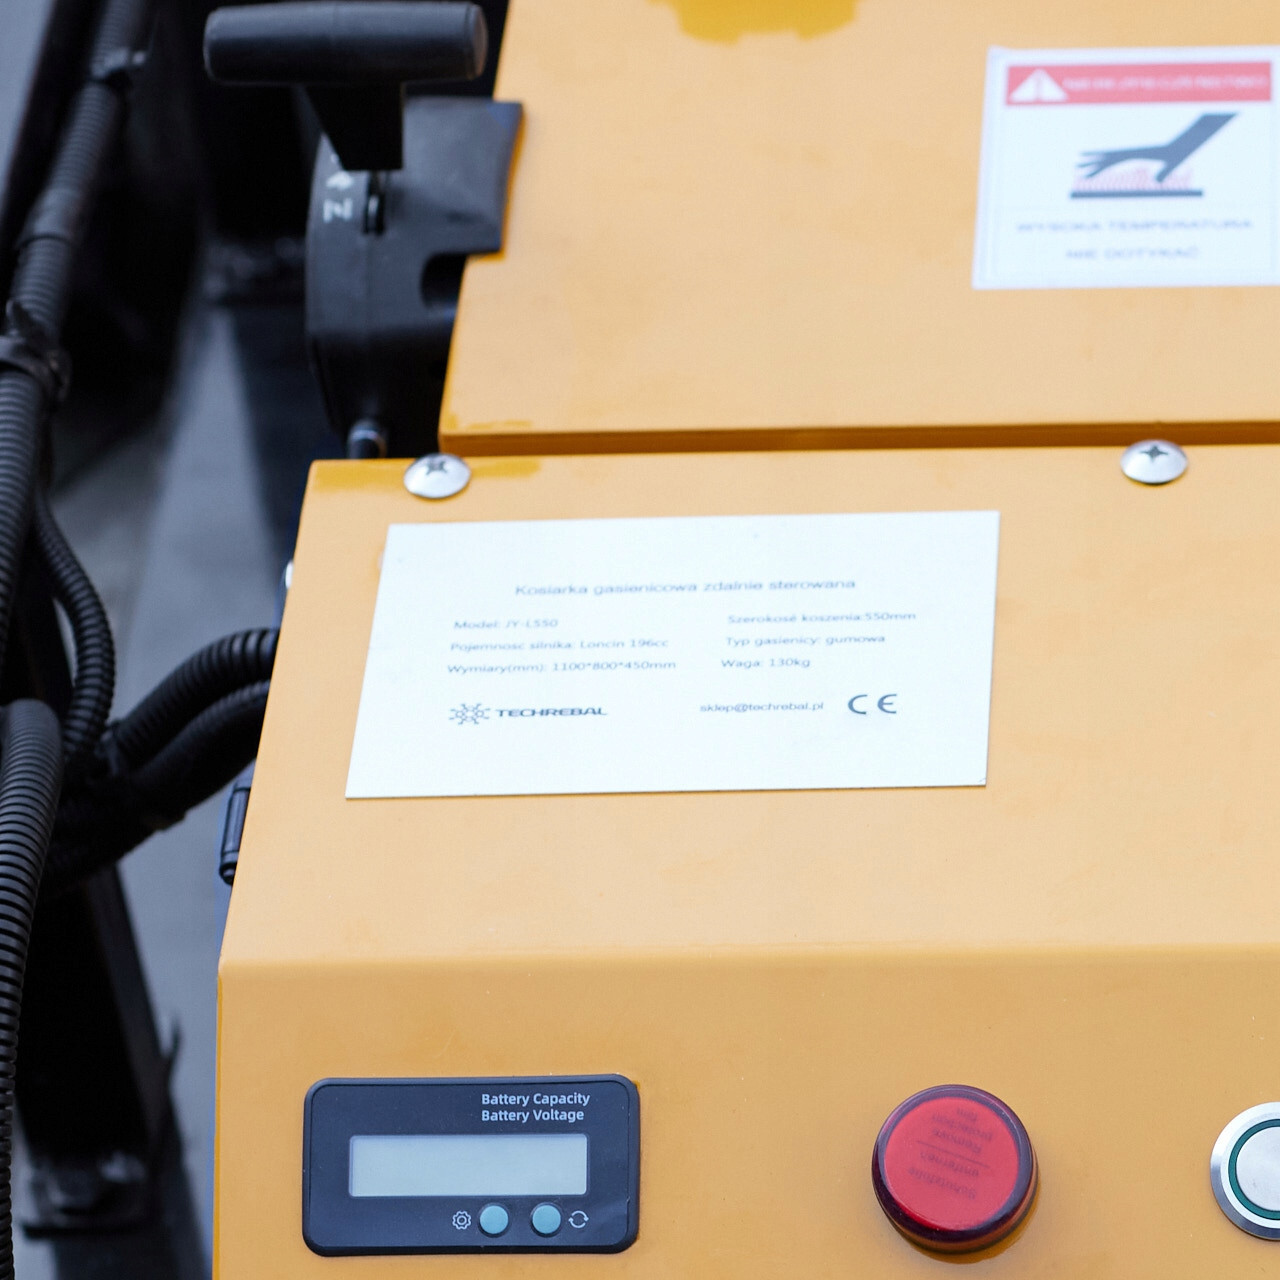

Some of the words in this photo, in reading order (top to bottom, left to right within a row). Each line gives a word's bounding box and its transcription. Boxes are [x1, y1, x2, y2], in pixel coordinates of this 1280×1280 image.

[514, 584, 589, 596] Kosiarka
[703, 581, 764, 592] zdalnie
[769, 580, 856, 590] sterowana
[579, 640, 626, 649] Loncin
[630, 638, 669, 648] 196cc
[726, 636, 751, 648] Typ
[825, 635, 886, 646] gumowa
[447, 663, 545, 675] Wymiary(mm):
[720, 659, 762, 670] Waga:
[770, 657, 811, 669] 130kg
[700, 701, 824, 713] sklep@techrebal.pl
[847, 693, 898, 716] CE
[496, 707, 607, 718] TECHREBAL
[481, 1093, 530, 1106] Battery
[533, 1092, 591, 1106] Capacity
[481, 1109, 530, 1123] Battery
[533, 1109, 585, 1123] Voltage
